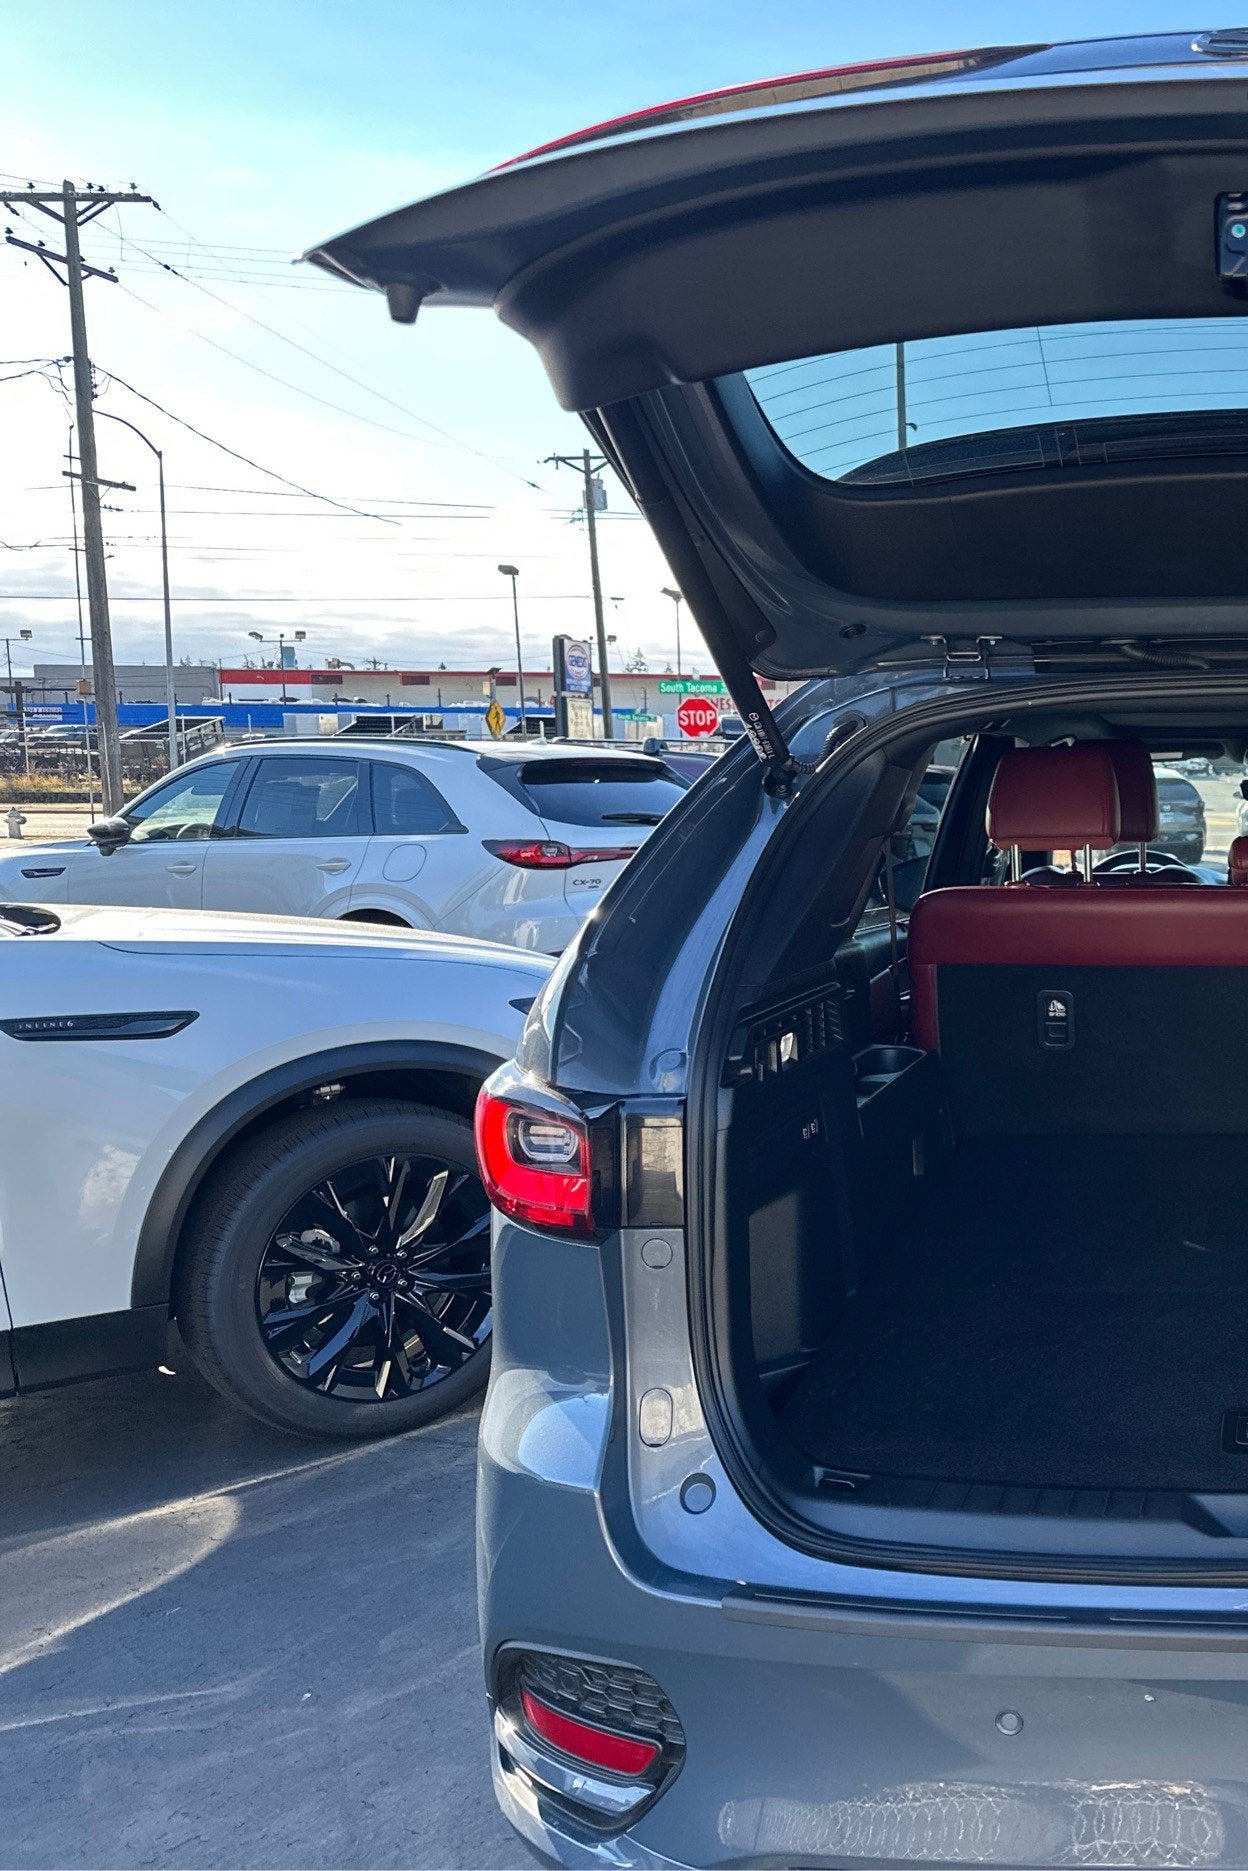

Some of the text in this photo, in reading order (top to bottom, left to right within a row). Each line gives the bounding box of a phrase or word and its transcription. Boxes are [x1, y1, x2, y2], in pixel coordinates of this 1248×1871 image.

[660, 682, 684, 693] South
[686, 682, 718, 693] Tacoma
[679, 710, 715, 726] STOP
